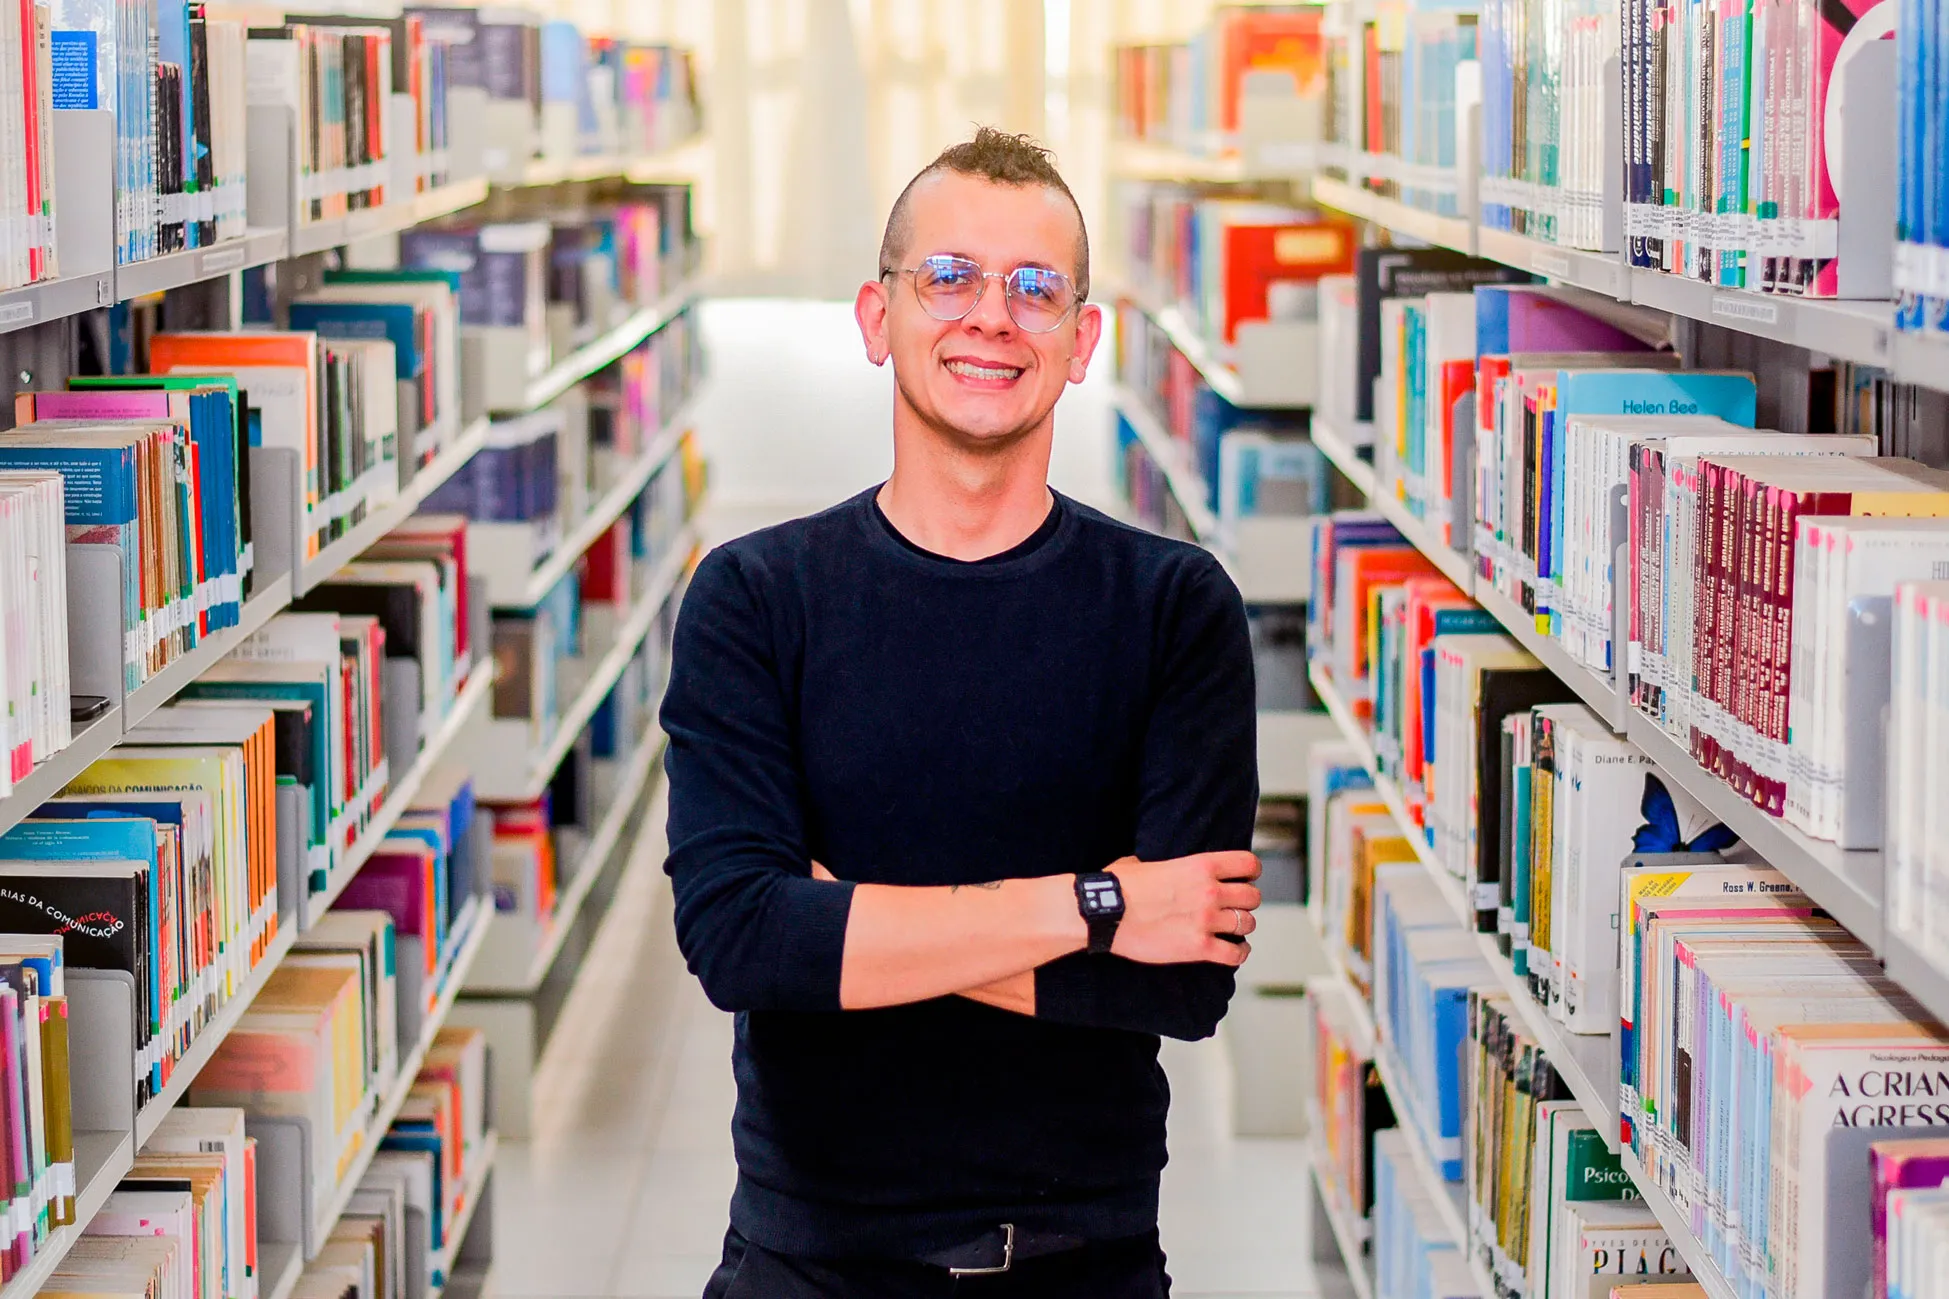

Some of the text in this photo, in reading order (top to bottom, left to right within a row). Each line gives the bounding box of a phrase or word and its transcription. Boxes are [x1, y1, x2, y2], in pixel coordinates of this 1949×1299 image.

[1632, 47, 1639, 60] da
[1646, 46, 1652, 60] da
[1632, 64, 1640, 164] Personalidade
[1645, 63, 1653, 164] Personalidade
[1622, 398, 1698, 414] Helen Bee
[1781, 511, 1789, 532] sell
[1721, 519, 1729, 567] Amatruda
[1753, 534, 1762, 584] Amatruda
[1763, 540, 1773, 591] Amatruda
[1778, 543, 1789, 595] Amatruda
[1765, 604, 1773, 659] Psicologia
[1781, 608, 1790, 664] Psicologia
[1771, 695, 1779, 735] Criança
[1595, 755, 1625, 764] Diane
[1627, 755, 1636, 764] E.
[1722, 881, 1744, 892] Ross
[1746, 881, 1756, 892] W.
[1759, 881, 1793, 893] Greene,
[0, 888, 124, 938] RIAS DA COMUNICAÇÃO
[1829, 1071, 1850, 1097] A
[1584, 1167, 1632, 1183] Psico
[1592, 1239, 1625, 1247] YVES
[1633, 1239, 1647, 1247] DE
[1592, 1247, 1691, 1274] PIAG
